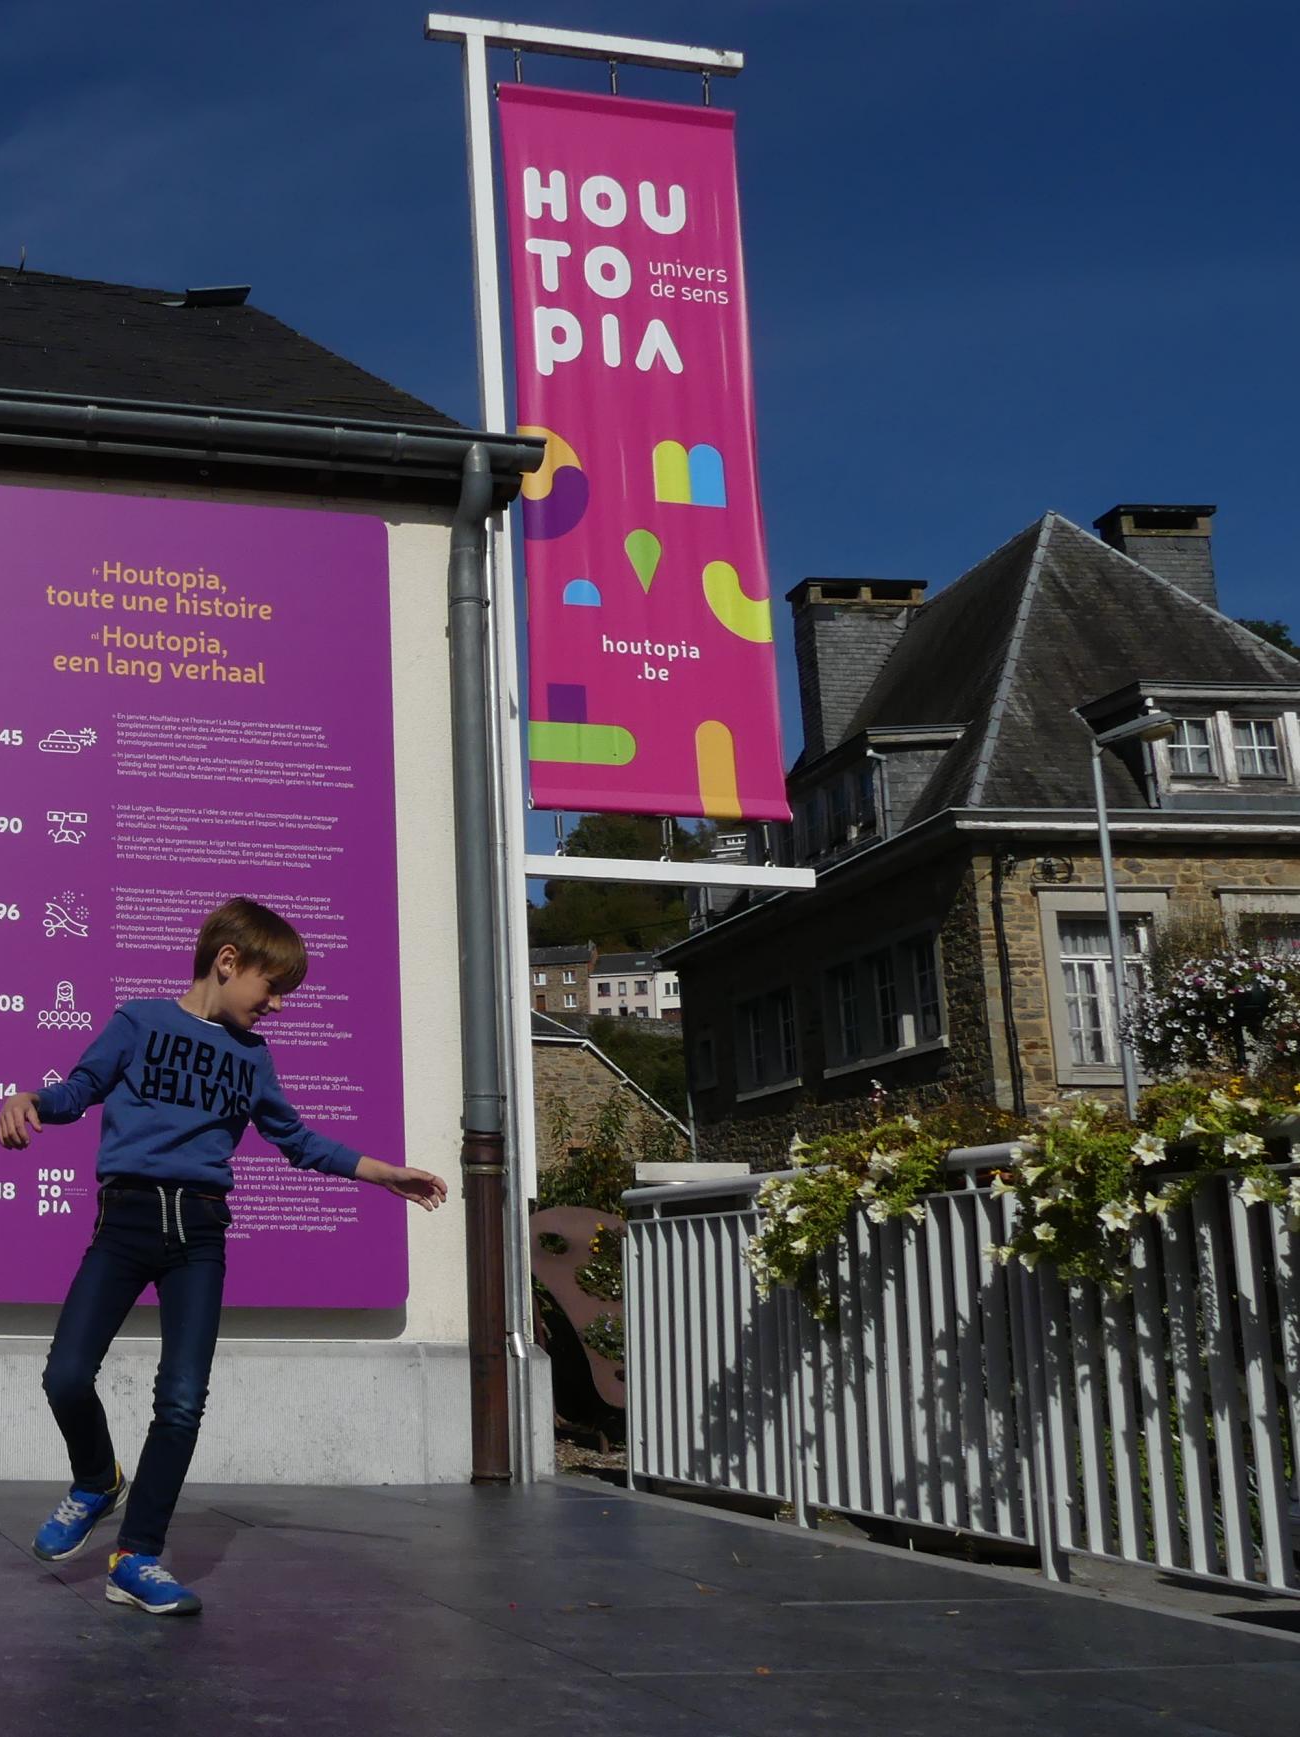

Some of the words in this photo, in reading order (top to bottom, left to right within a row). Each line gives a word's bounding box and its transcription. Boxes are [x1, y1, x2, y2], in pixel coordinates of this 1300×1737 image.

[523, 167, 686, 235] HOU
[525, 238, 632, 299] TO
[649, 258, 728, 283] univers
[650, 279, 675, 298] de
[681, 285, 729, 305] sens
[104, 561, 226, 593] Houtopia,
[46, 586, 114, 609] toute
[123, 595, 168, 613] une
[176, 592, 272, 620] histoire
[103, 625, 227, 657] Houtopia,
[602, 635, 700, 661] houtopia
[54, 655, 98, 673] een
[108, 652, 161, 683] lang
[169, 656, 265, 684] verhaal
[637, 662, 669, 681] .be
[145, 1030, 256, 1097] URBAN
[140, 1066, 251, 1119] SKATER
[39, 1168, 74, 1182] HOU
[38, 1185, 61, 1198] TO
